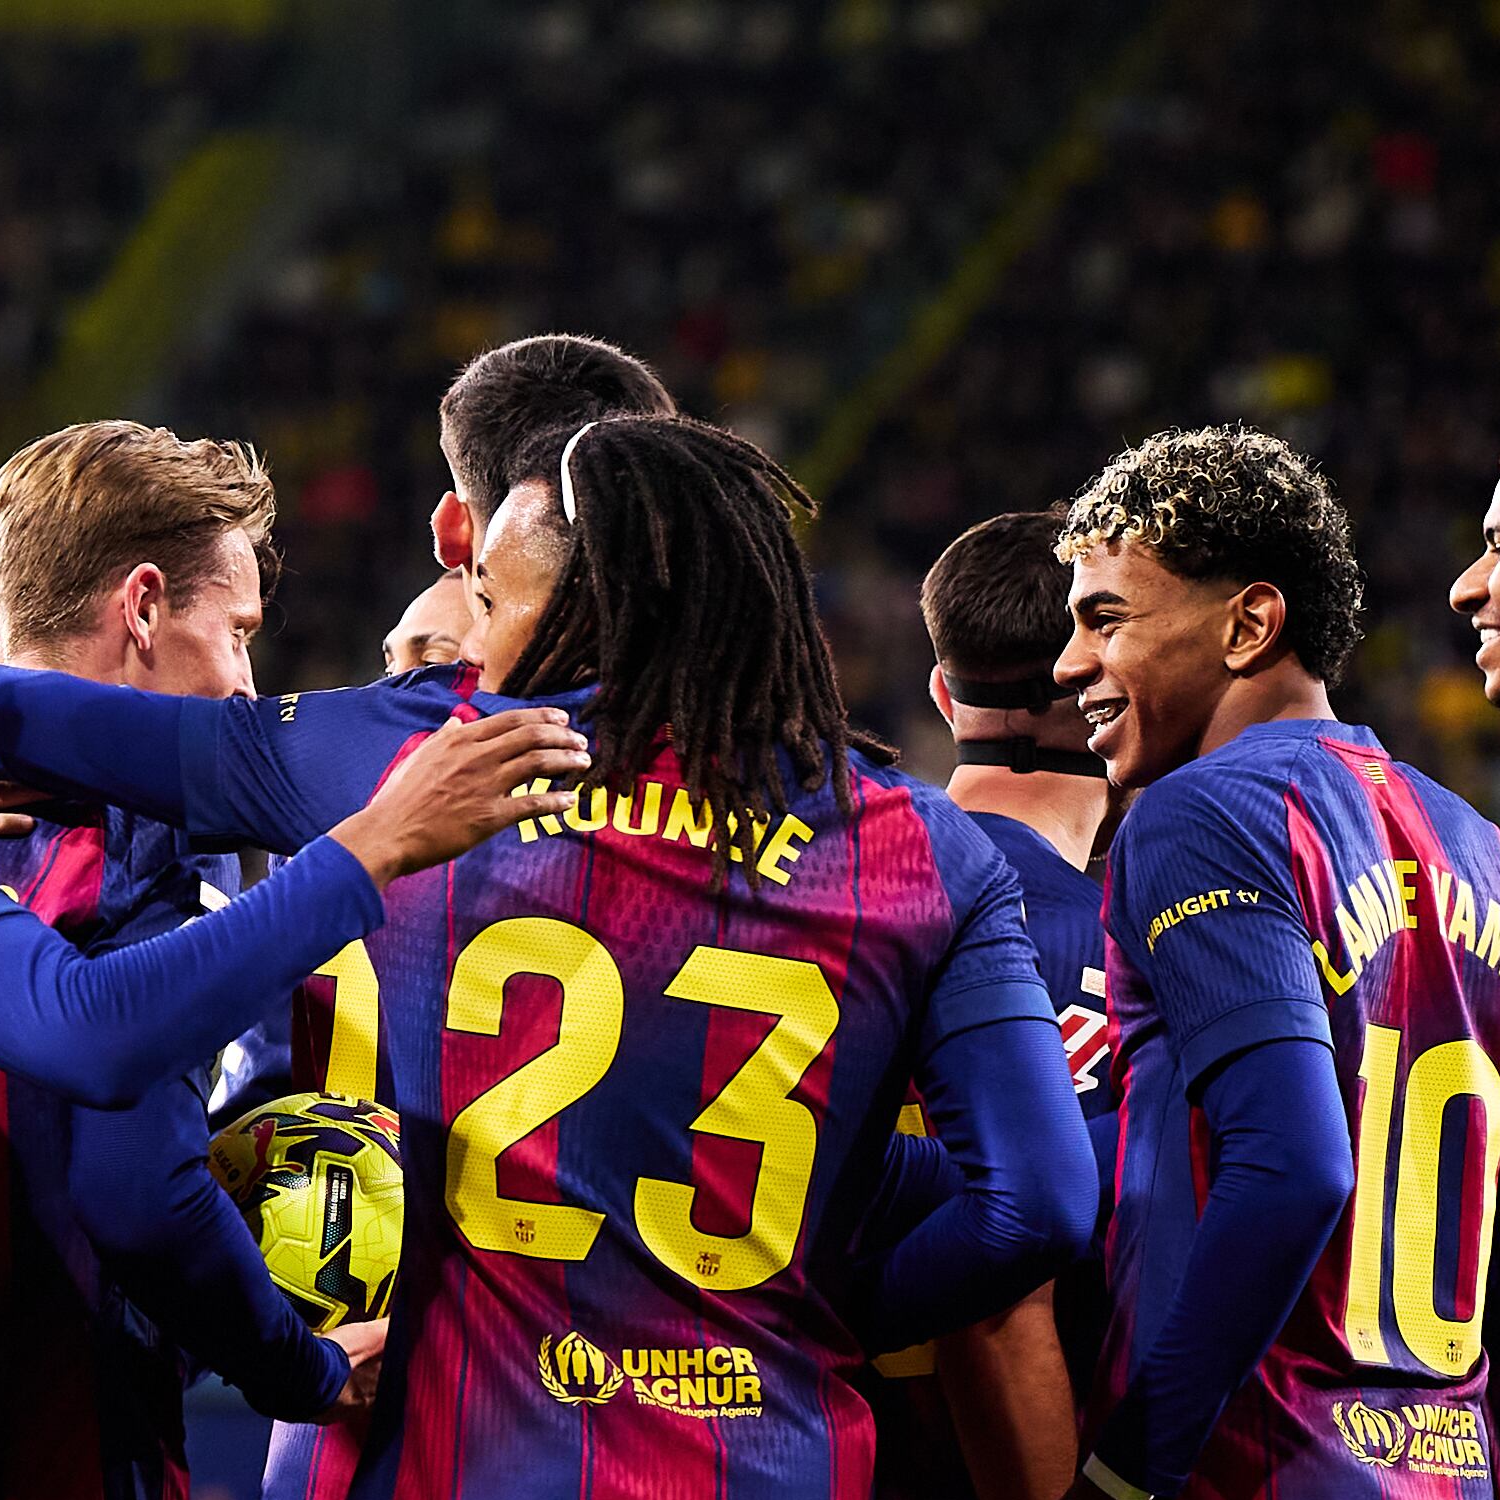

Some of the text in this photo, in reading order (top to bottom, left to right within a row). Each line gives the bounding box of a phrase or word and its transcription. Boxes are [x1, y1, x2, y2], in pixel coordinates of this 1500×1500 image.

[1236, 889, 1259, 904] tv
[445, 915, 840, 1291] 23
[622, 1346, 758, 1377] UNHCR
[633, 1375, 762, 1406] ACNUR
[672, 1405, 718, 1418] Refugee
[719, 1405, 763, 1420] Agency
[1400, 1404, 1478, 1439] UNHCR
[1407, 1431, 1486, 1466] ACNUR
